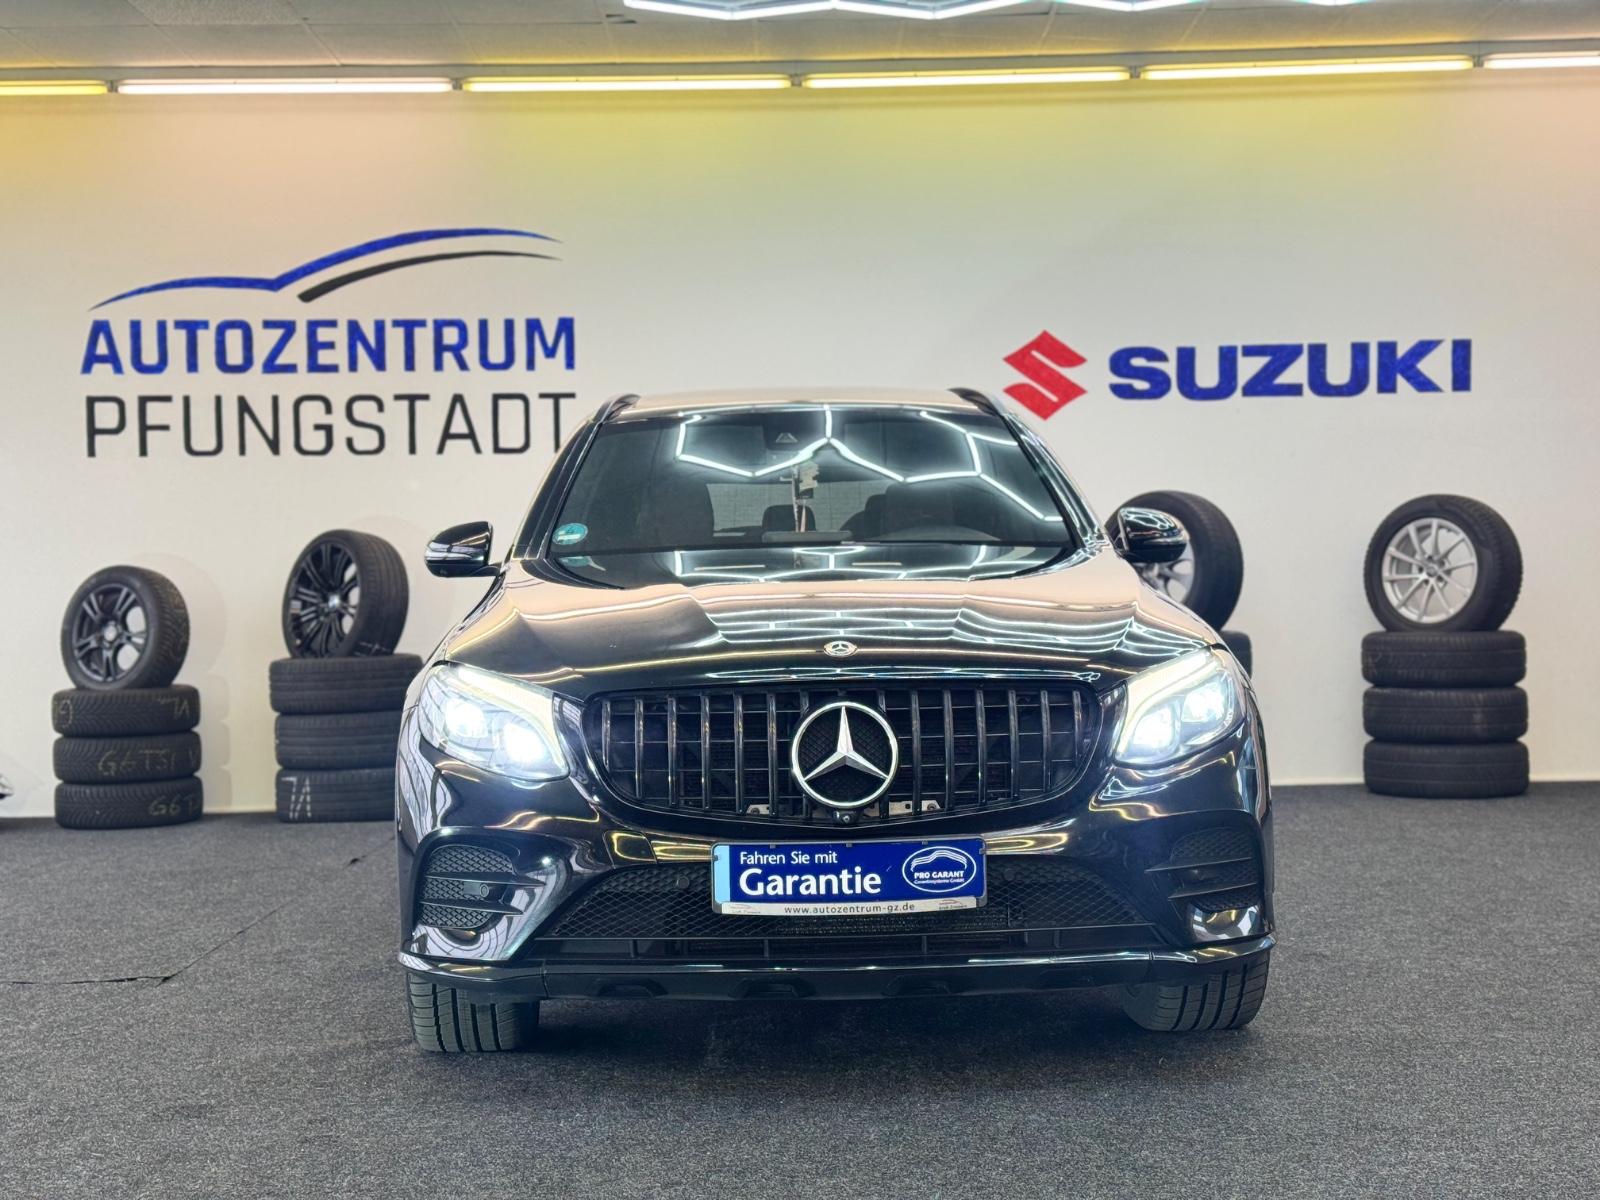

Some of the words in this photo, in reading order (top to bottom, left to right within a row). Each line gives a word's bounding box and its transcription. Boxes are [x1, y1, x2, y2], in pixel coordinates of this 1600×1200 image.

[80, 317, 576, 375] AUTOZENTRUM
[1108, 338, 1472, 401] SUZUKI
[85, 392, 577, 458] PFUNGSTADT
[740, 851, 786, 865] Fahren
[790, 851, 810, 864] Sie
[814, 850, 838, 864] mit
[739, 866, 882, 896] Garantie
[914, 871, 930, 879] PRO
[932, 870, 965, 879] GARANT
[784, 902, 915, 914] www.autozentrum-gz.de
